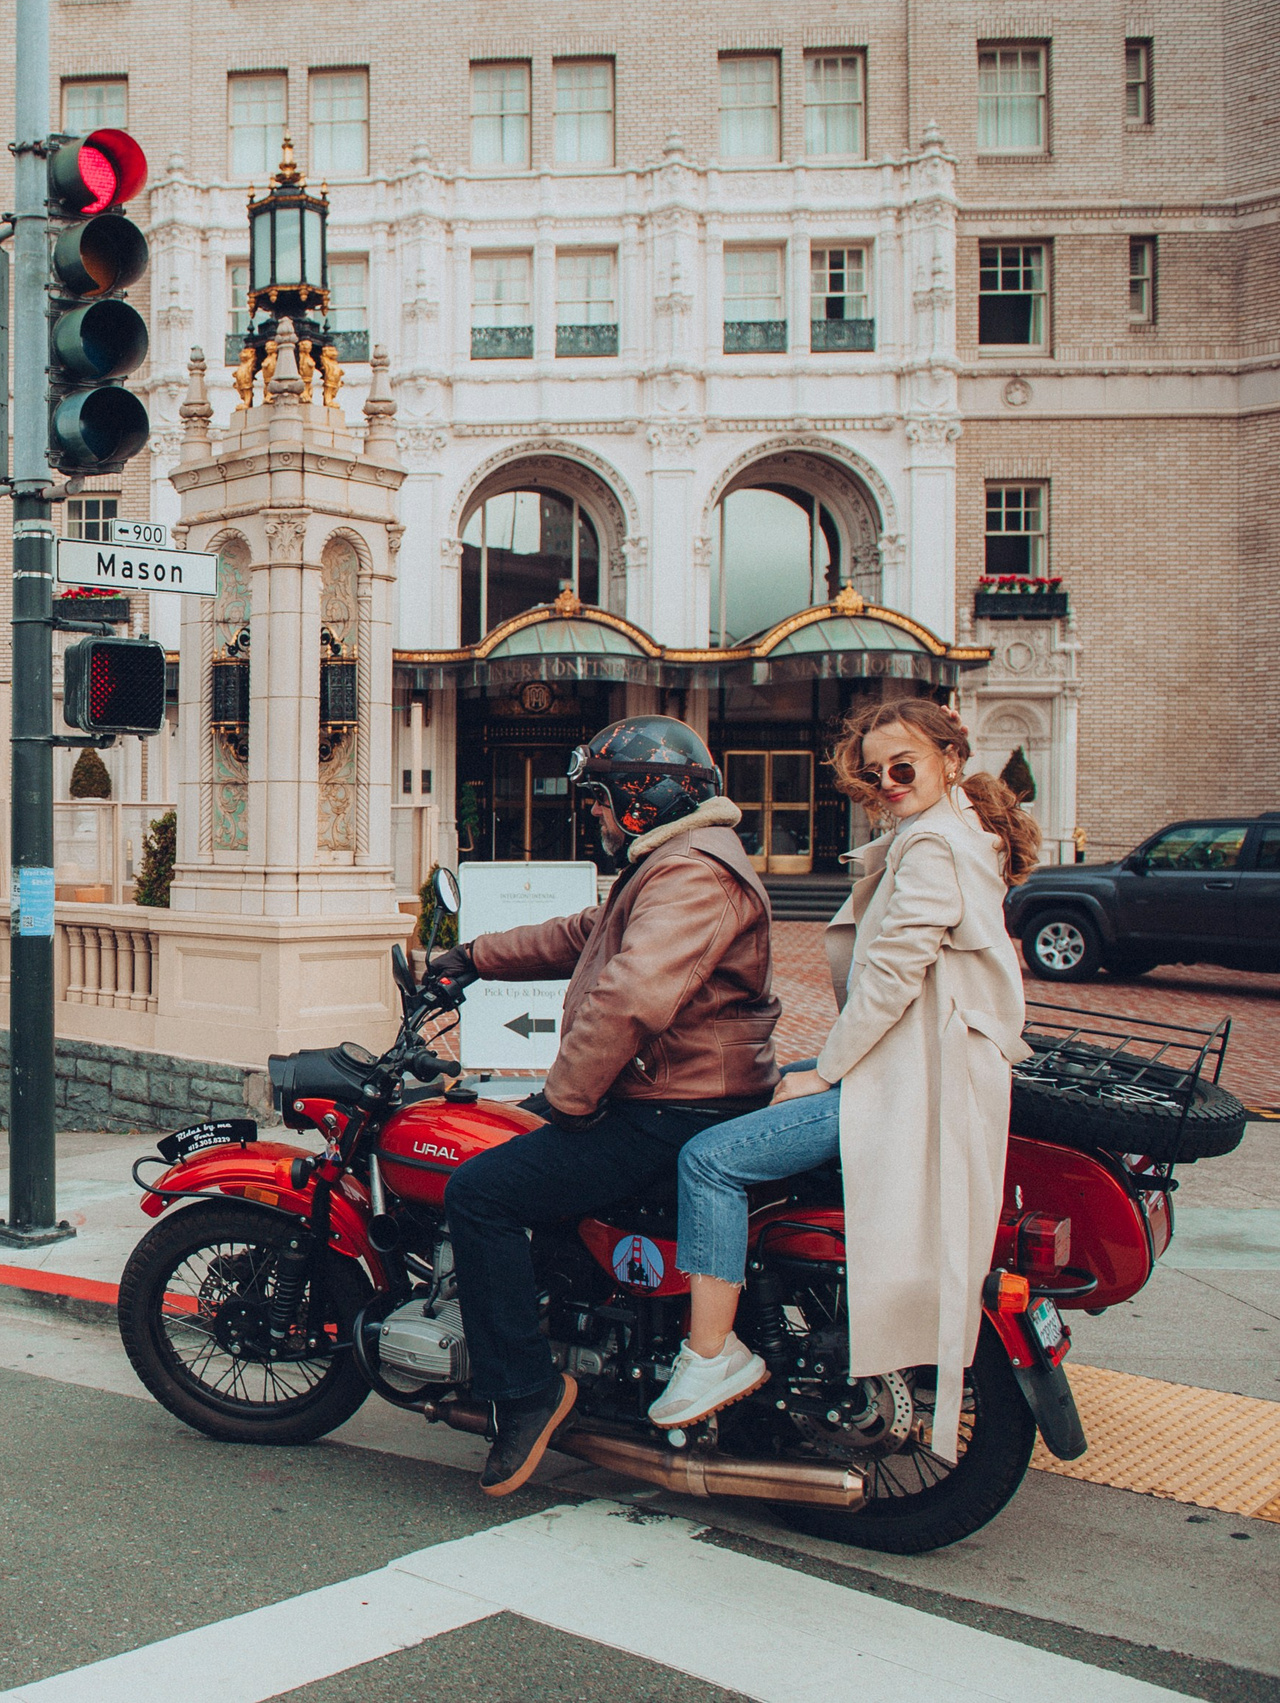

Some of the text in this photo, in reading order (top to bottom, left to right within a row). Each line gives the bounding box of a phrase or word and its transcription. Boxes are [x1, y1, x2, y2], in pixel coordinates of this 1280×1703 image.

[133, 525, 162, 543] 900
[97, 552, 182, 583] Mason
[484, 988, 503, 997] Pick
[506, 988, 520, 998] Up
[522, 988, 530, 997] &
[532, 988, 555, 998] Drop
[175, 1126, 202, 1142] Rides
[203, 1123, 215, 1131] by
[413, 1141, 459, 1160] URAL
